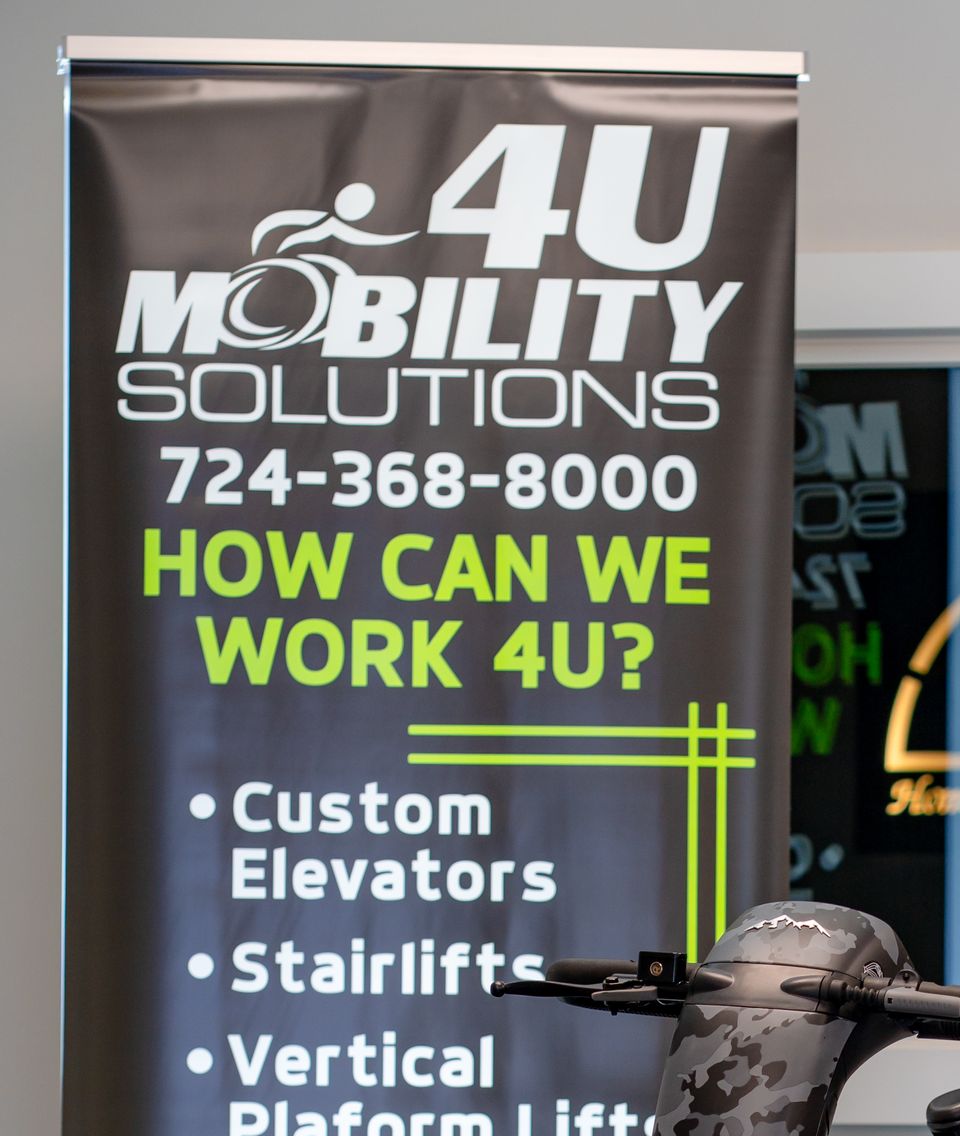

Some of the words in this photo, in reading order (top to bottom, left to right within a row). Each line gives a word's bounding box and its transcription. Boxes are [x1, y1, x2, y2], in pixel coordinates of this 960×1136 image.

[426, 123, 731, 272] 4U
[115, 253, 745, 364] MOBILITY
[116, 360, 721, 431] SOLUTIONS
[159, 446, 698, 512] 724-368-8000
[142, 528, 355, 601] HOW
[380, 533, 549, 603] CAN
[575, 535, 712, 605] WE
[195, 615, 464, 689] WORK
[493, 620, 655, 691] 4U?
[231, 780, 492, 836] Custom
[230, 845, 558, 903] Elevators
[230, 937, 547, 996] Stairlifts
[227, 1030, 495, 1089] Vertical
